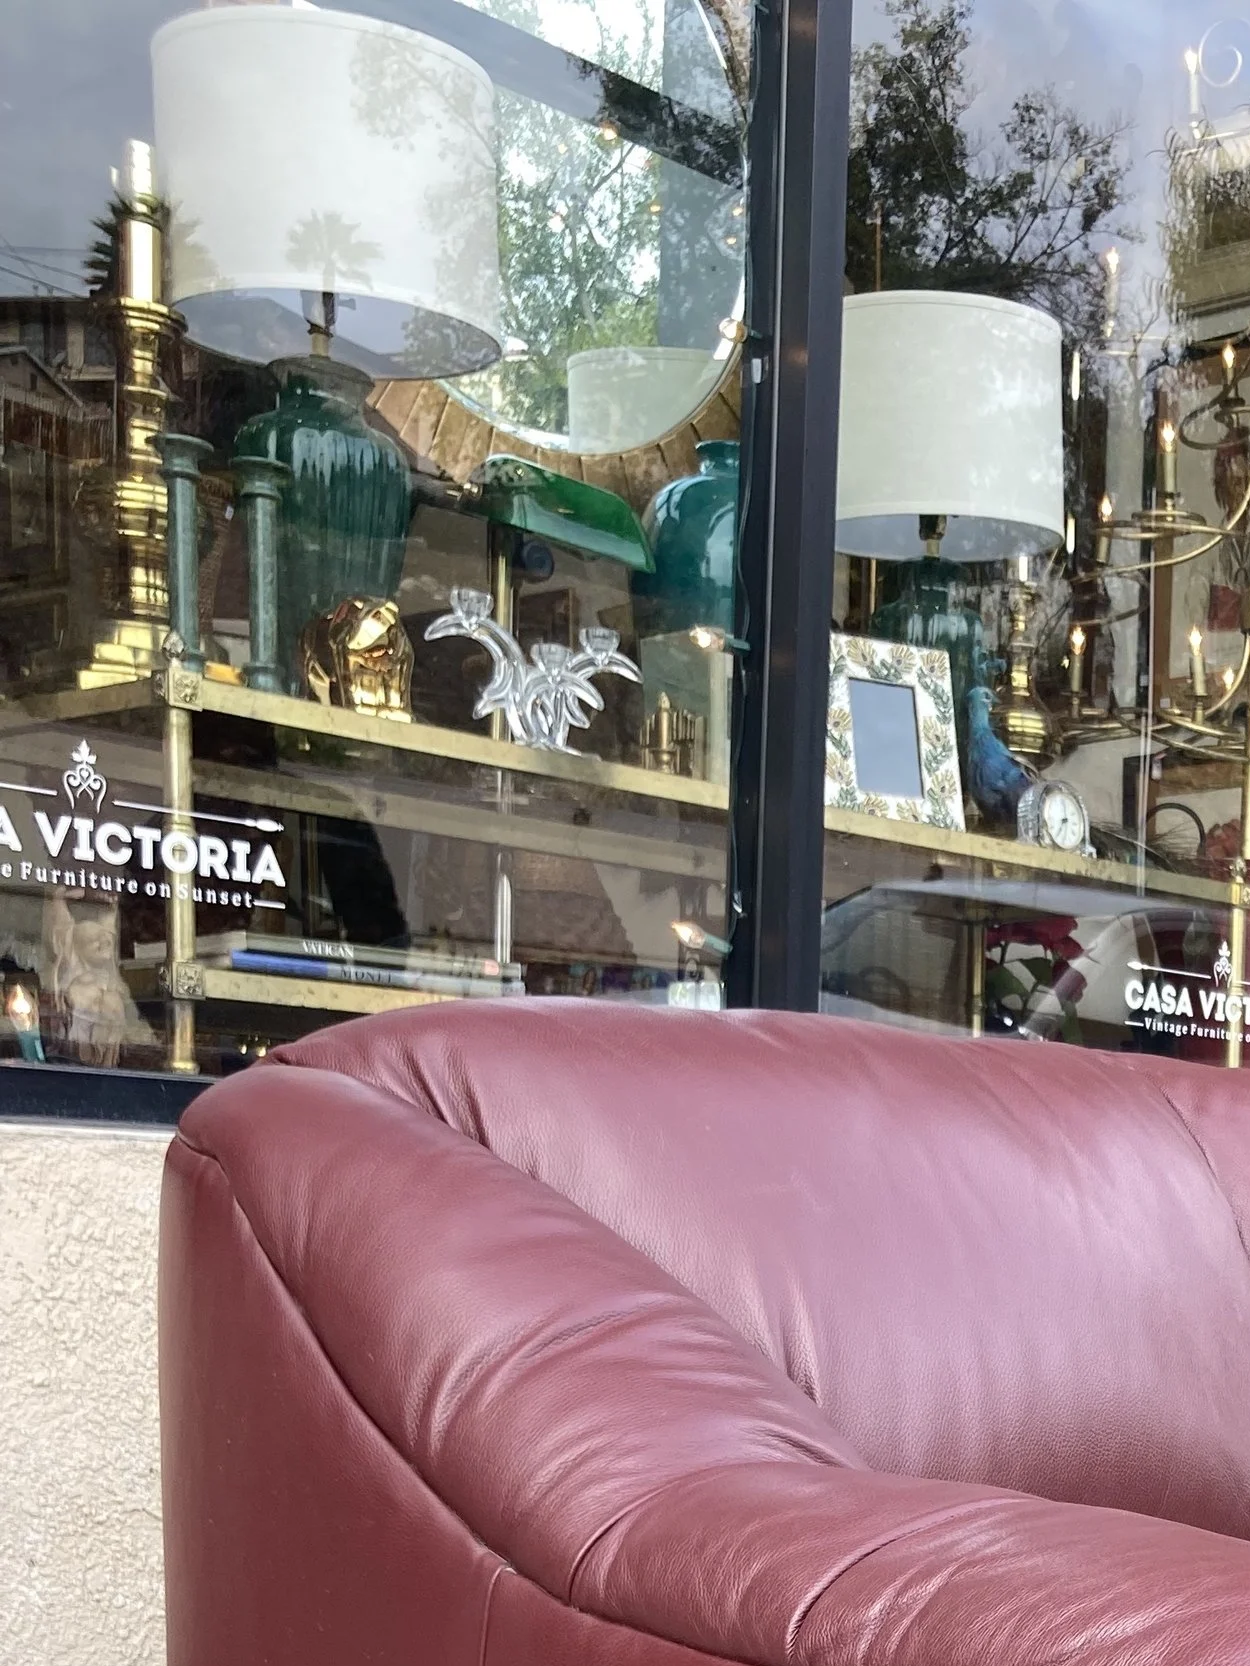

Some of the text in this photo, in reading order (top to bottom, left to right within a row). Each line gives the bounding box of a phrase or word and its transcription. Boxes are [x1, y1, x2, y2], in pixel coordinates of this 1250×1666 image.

[33, 811, 286, 888] VICTORIA
[20, 861, 138, 893] Furniture
[145, 881, 171, 898] on
[176, 881, 252, 908] Sunset
[302, 939, 354, 958] VATICAN
[1125, 979, 1193, 1018] CASA
[1144, 1017, 1188, 1037] Vintage
